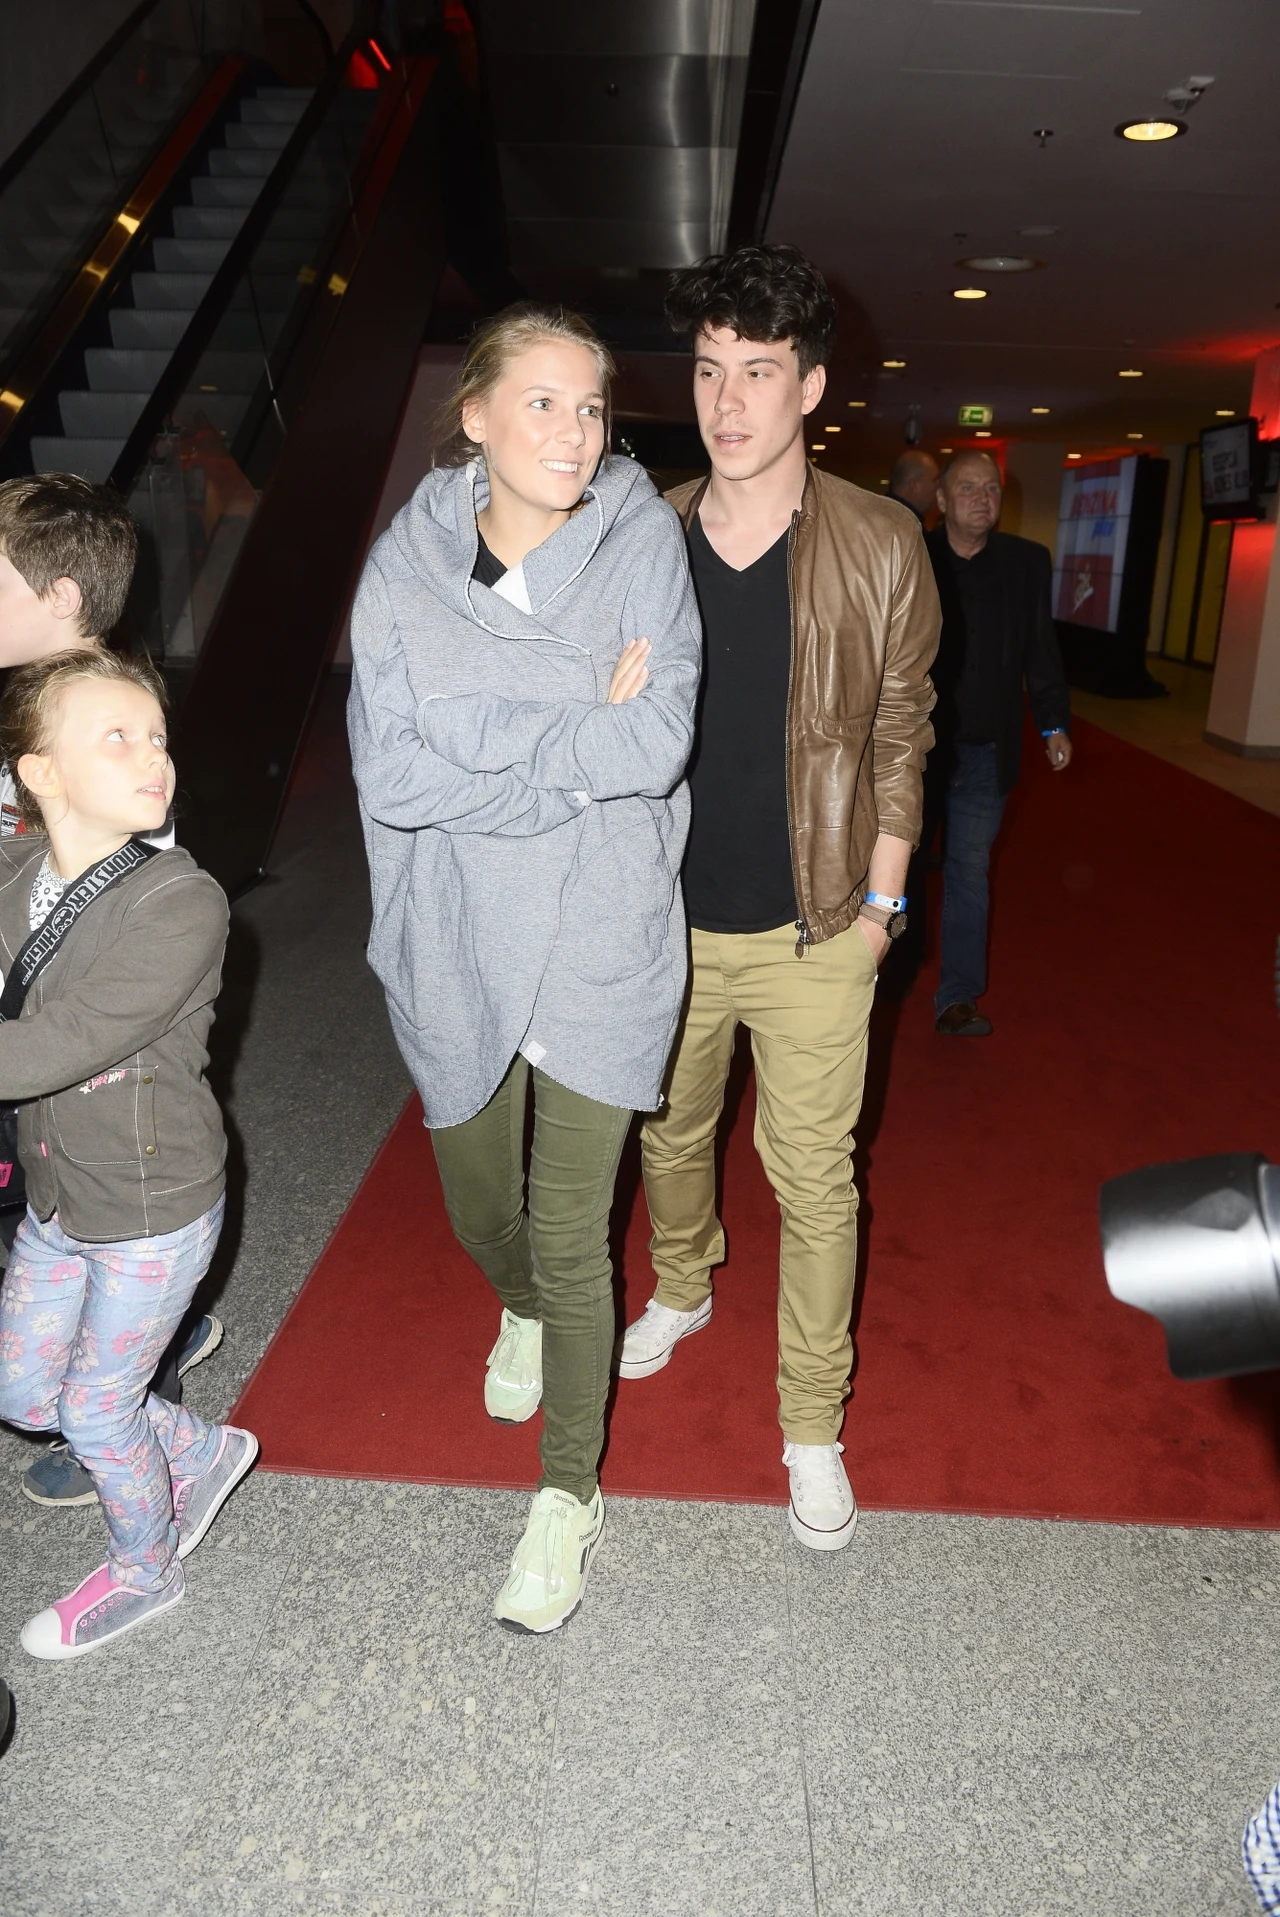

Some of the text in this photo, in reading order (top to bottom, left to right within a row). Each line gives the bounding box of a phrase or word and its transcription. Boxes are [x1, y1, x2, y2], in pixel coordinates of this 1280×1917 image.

[21, 843, 148, 972] MONSTER HIGH
[553, 1493, 575, 1507] Reebok
